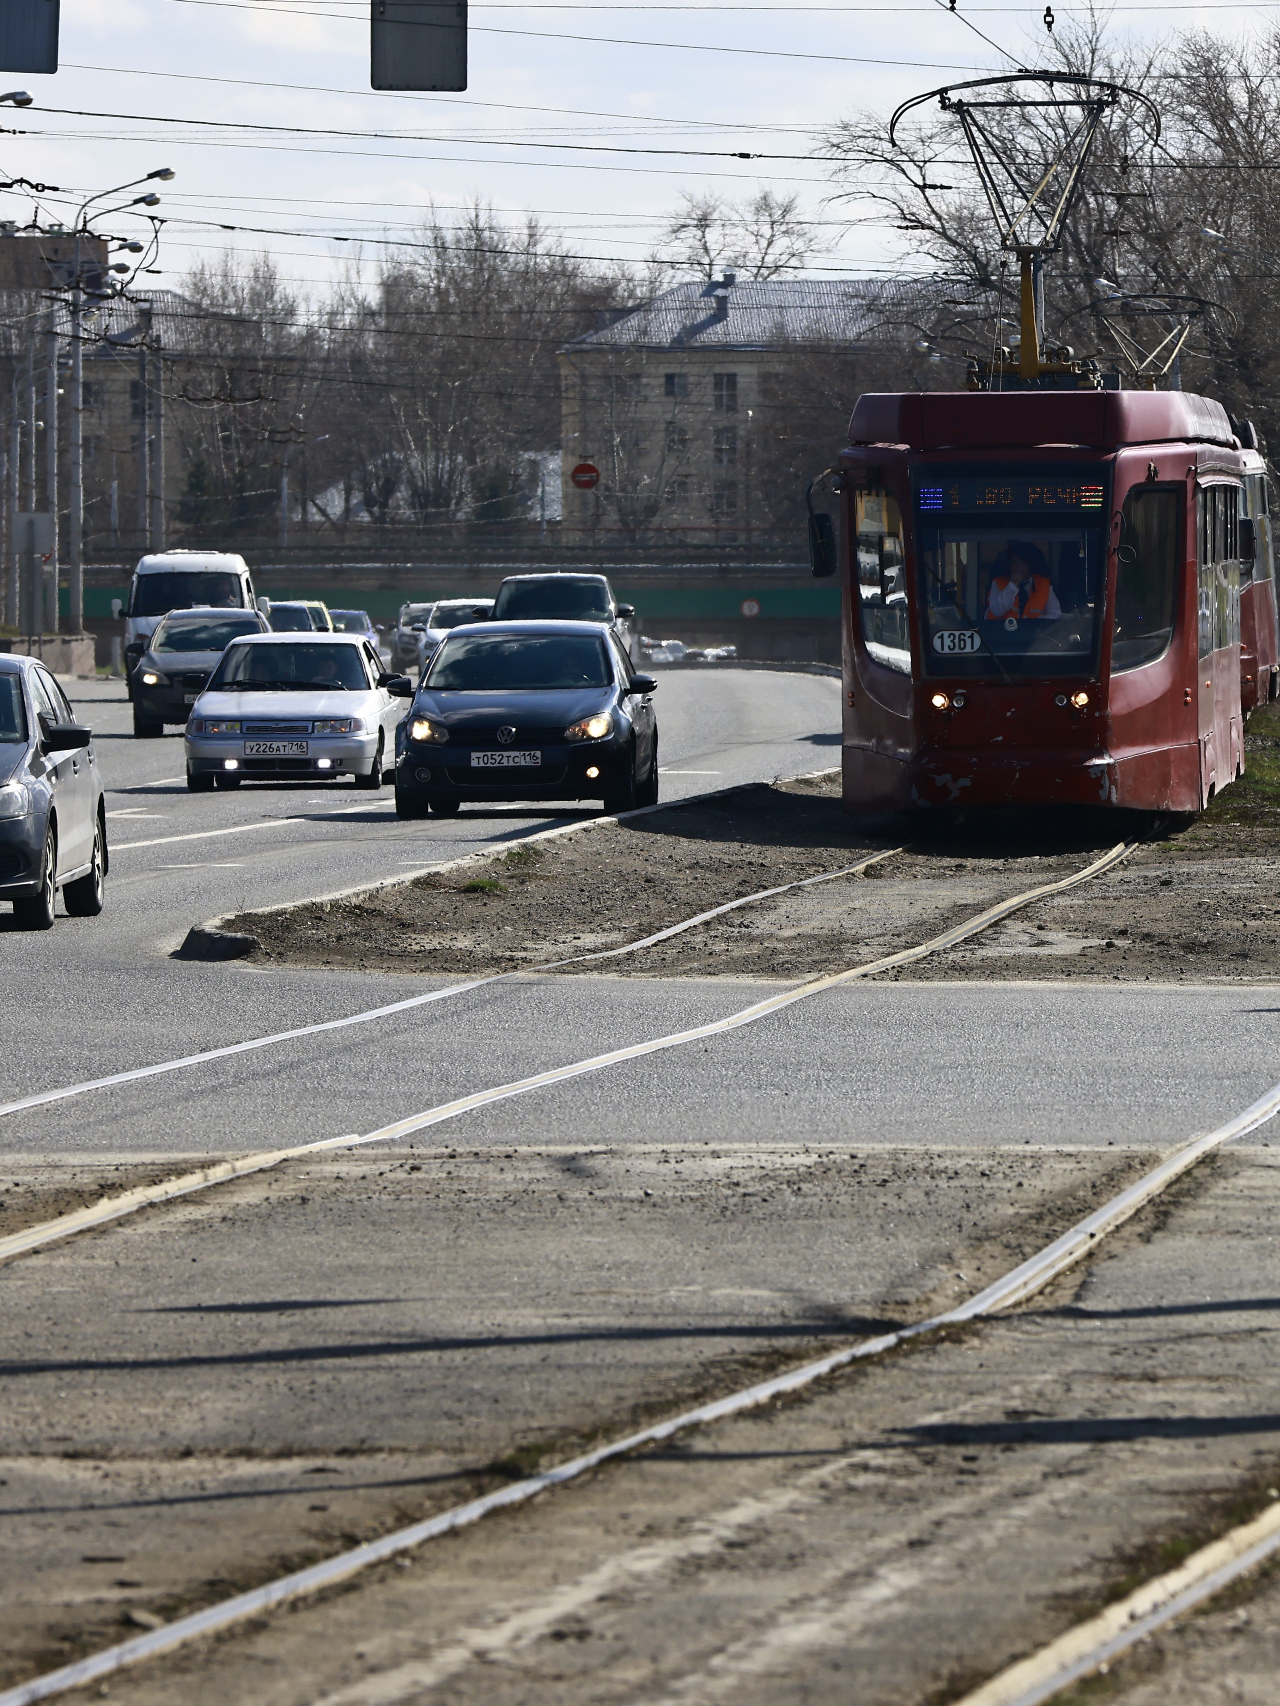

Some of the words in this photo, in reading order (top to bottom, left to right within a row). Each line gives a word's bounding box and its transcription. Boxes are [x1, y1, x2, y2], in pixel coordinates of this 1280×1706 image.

[937, 632, 975, 652] 1361
[249, 743, 287, 754] У226АТ
[289, 742, 305, 750] 716
[475, 754, 520, 765] Т052ТС
[521, 752, 538, 761] 116
